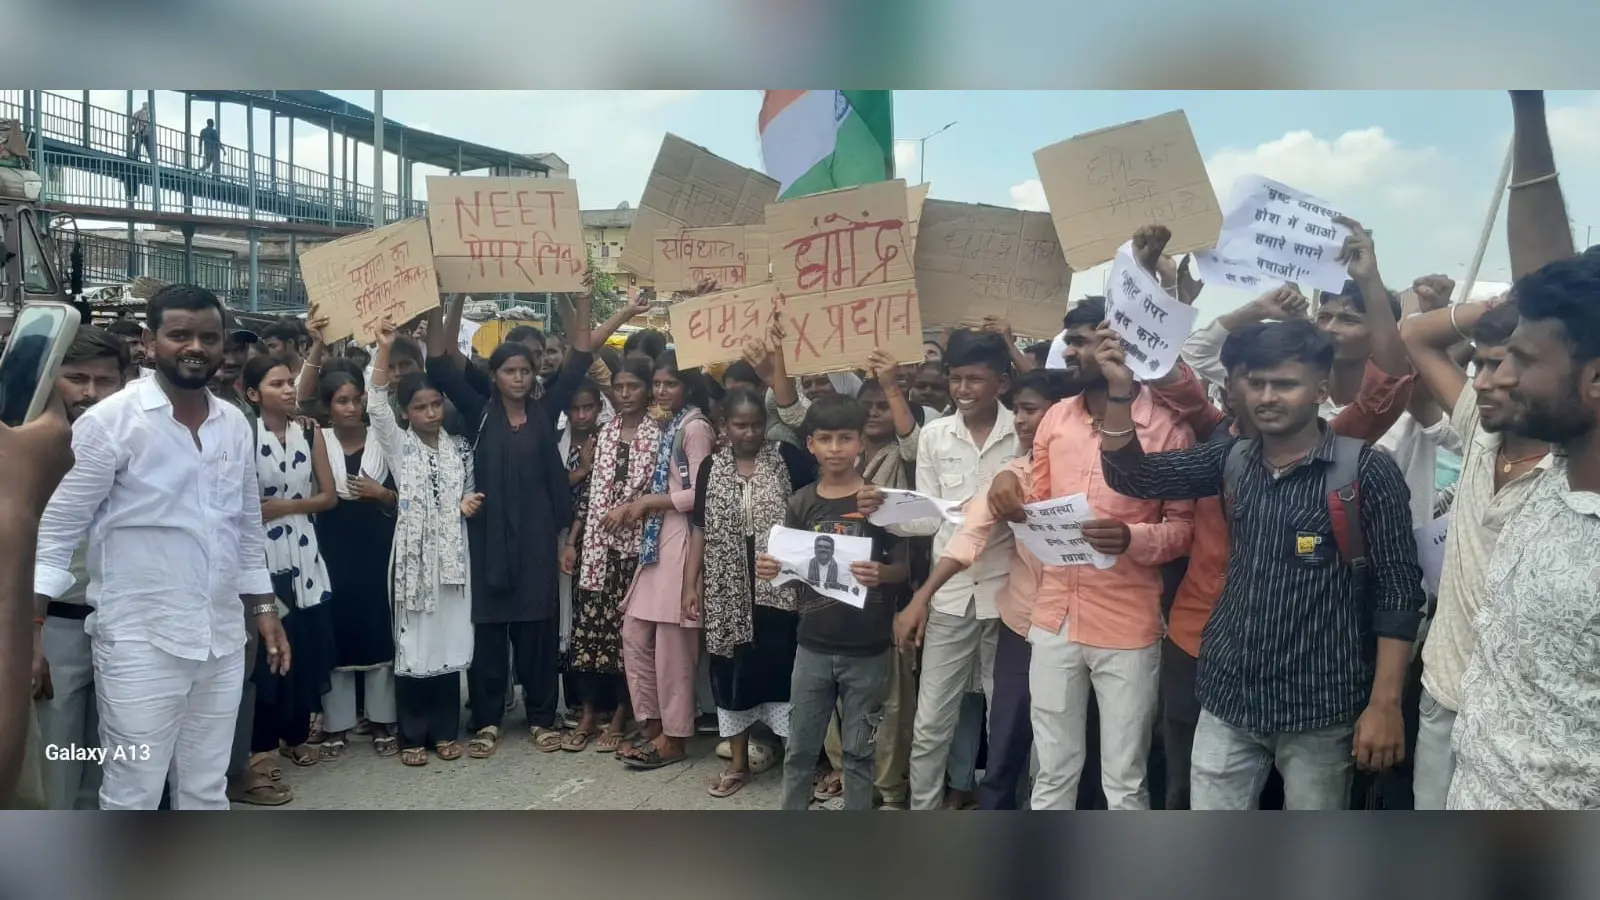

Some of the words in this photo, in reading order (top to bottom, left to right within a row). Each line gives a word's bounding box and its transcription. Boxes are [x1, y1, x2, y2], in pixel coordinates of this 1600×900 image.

[455, 190, 565, 240] NEET
[463, 233, 535, 286] पेपर
[1143, 294, 1168, 324] पेपर
[1039, 503, 1073, 517] व्यवस्था
